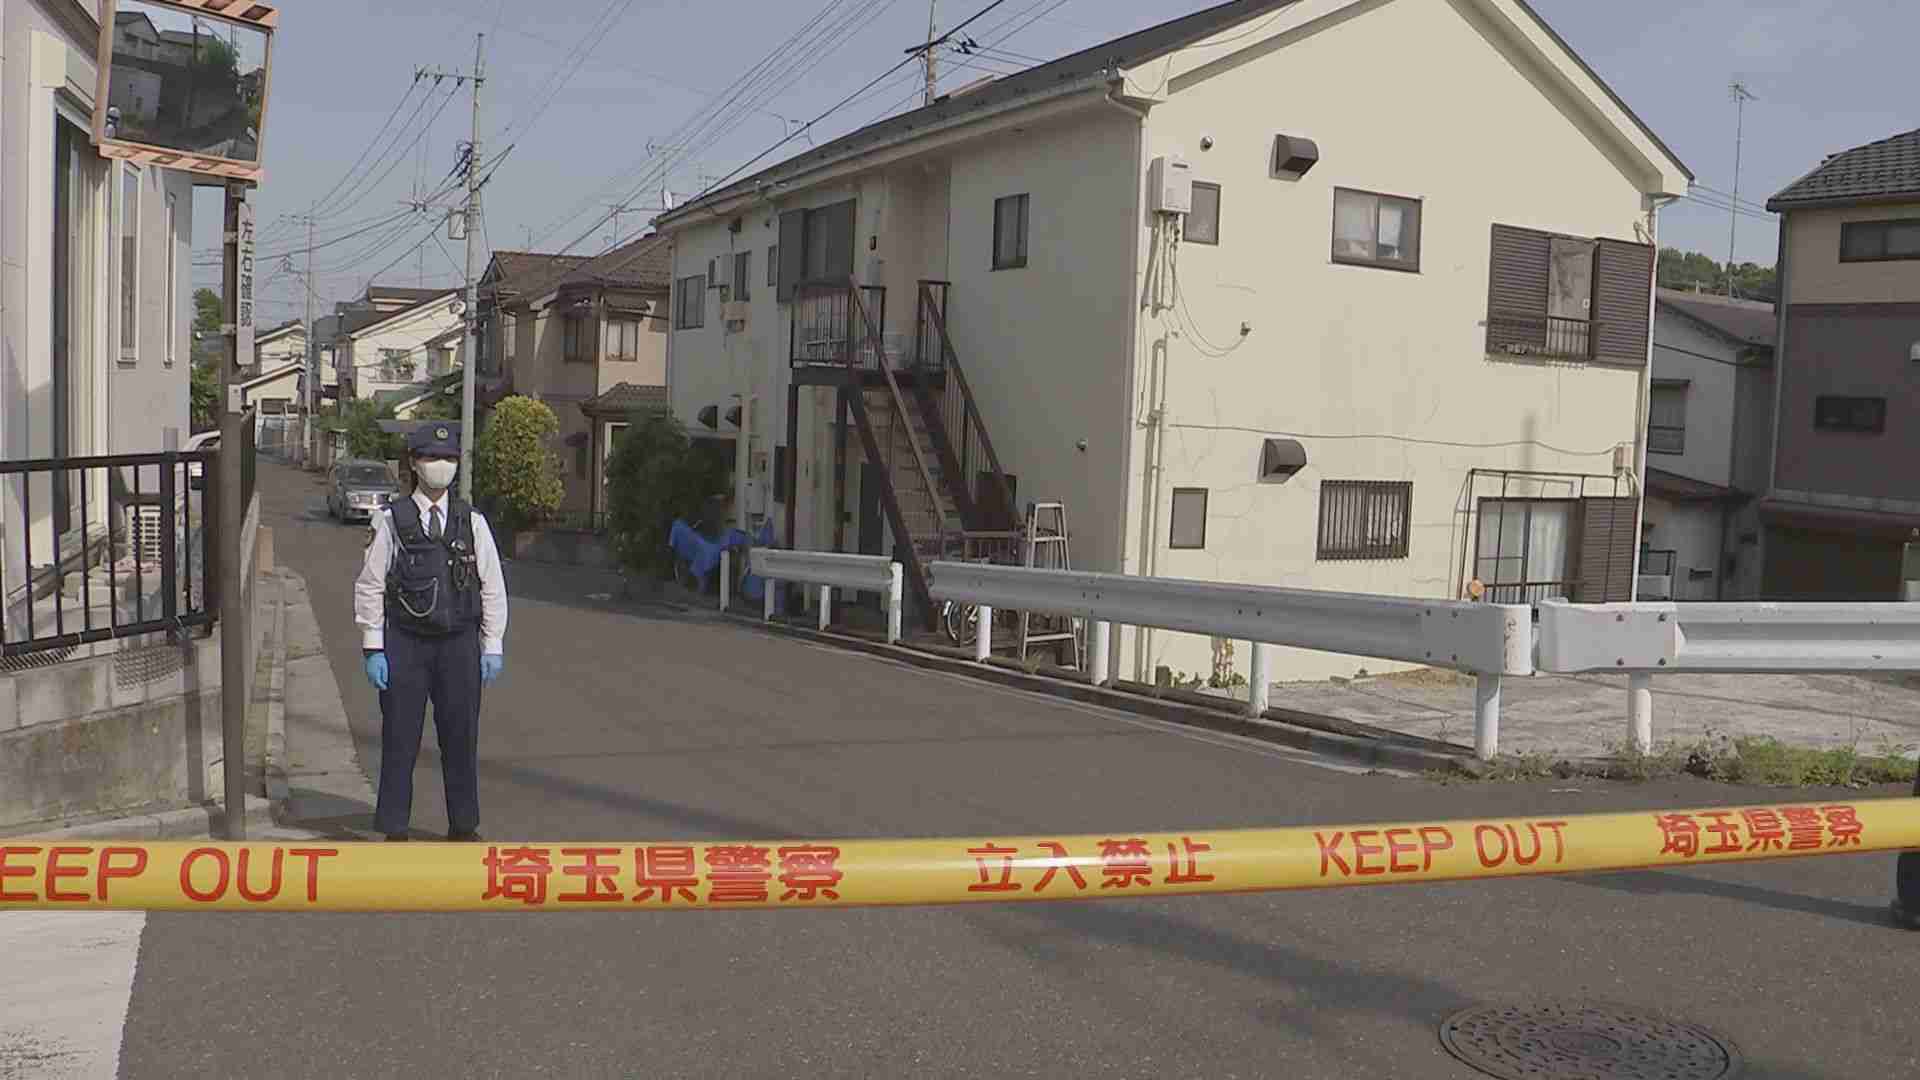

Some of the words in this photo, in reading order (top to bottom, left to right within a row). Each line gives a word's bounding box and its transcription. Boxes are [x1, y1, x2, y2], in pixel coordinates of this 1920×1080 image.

[240, 218, 254, 328] 左右確認
[1314, 826, 1457, 877] KEEP
[1472, 821, 1569, 870] OUT
[1655, 804, 1865, 859] 埼玉県警察
[179, 847, 338, 906] OUT
[480, 844, 843, 908] 埼玉県警察
[967, 836, 1216, 894] 立入禁止
